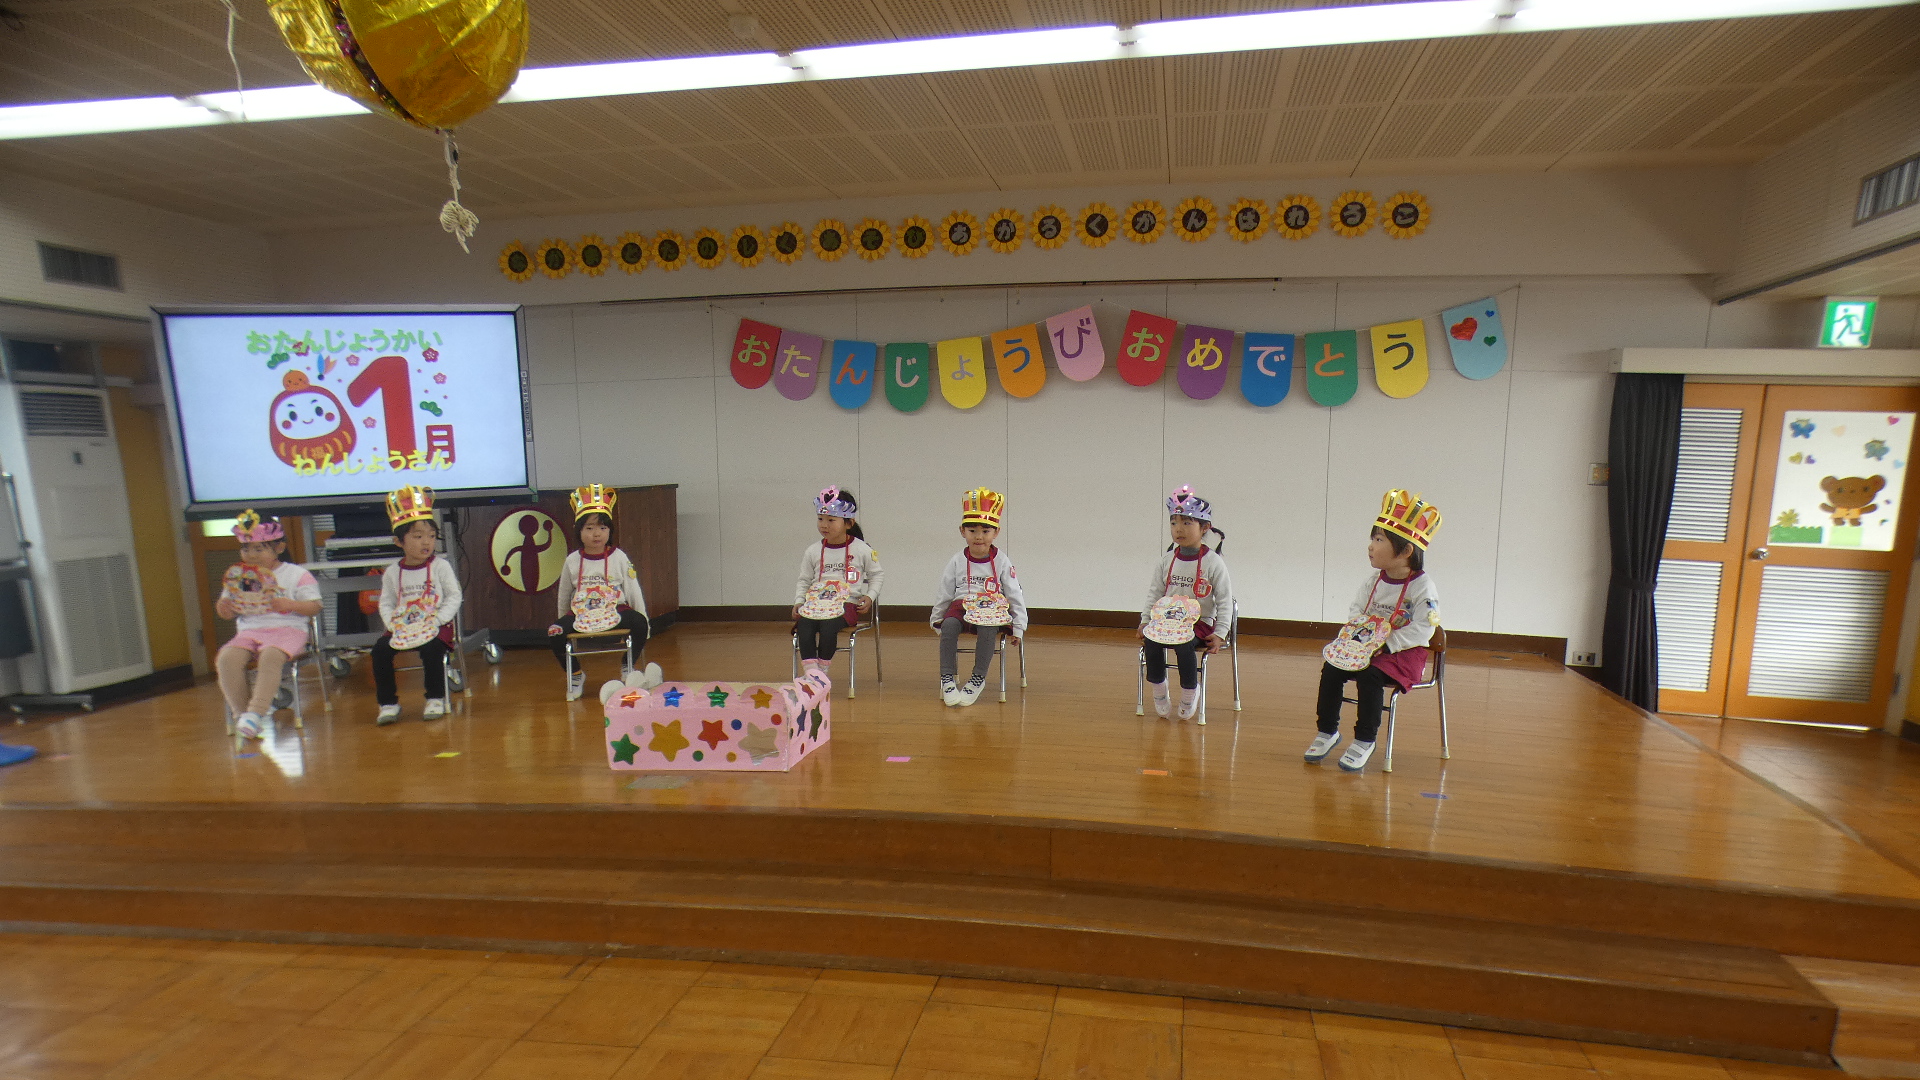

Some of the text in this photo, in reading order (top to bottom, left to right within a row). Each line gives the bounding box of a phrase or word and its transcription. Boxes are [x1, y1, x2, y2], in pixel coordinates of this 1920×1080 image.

[246, 328, 443, 353] おたんじょうかい
